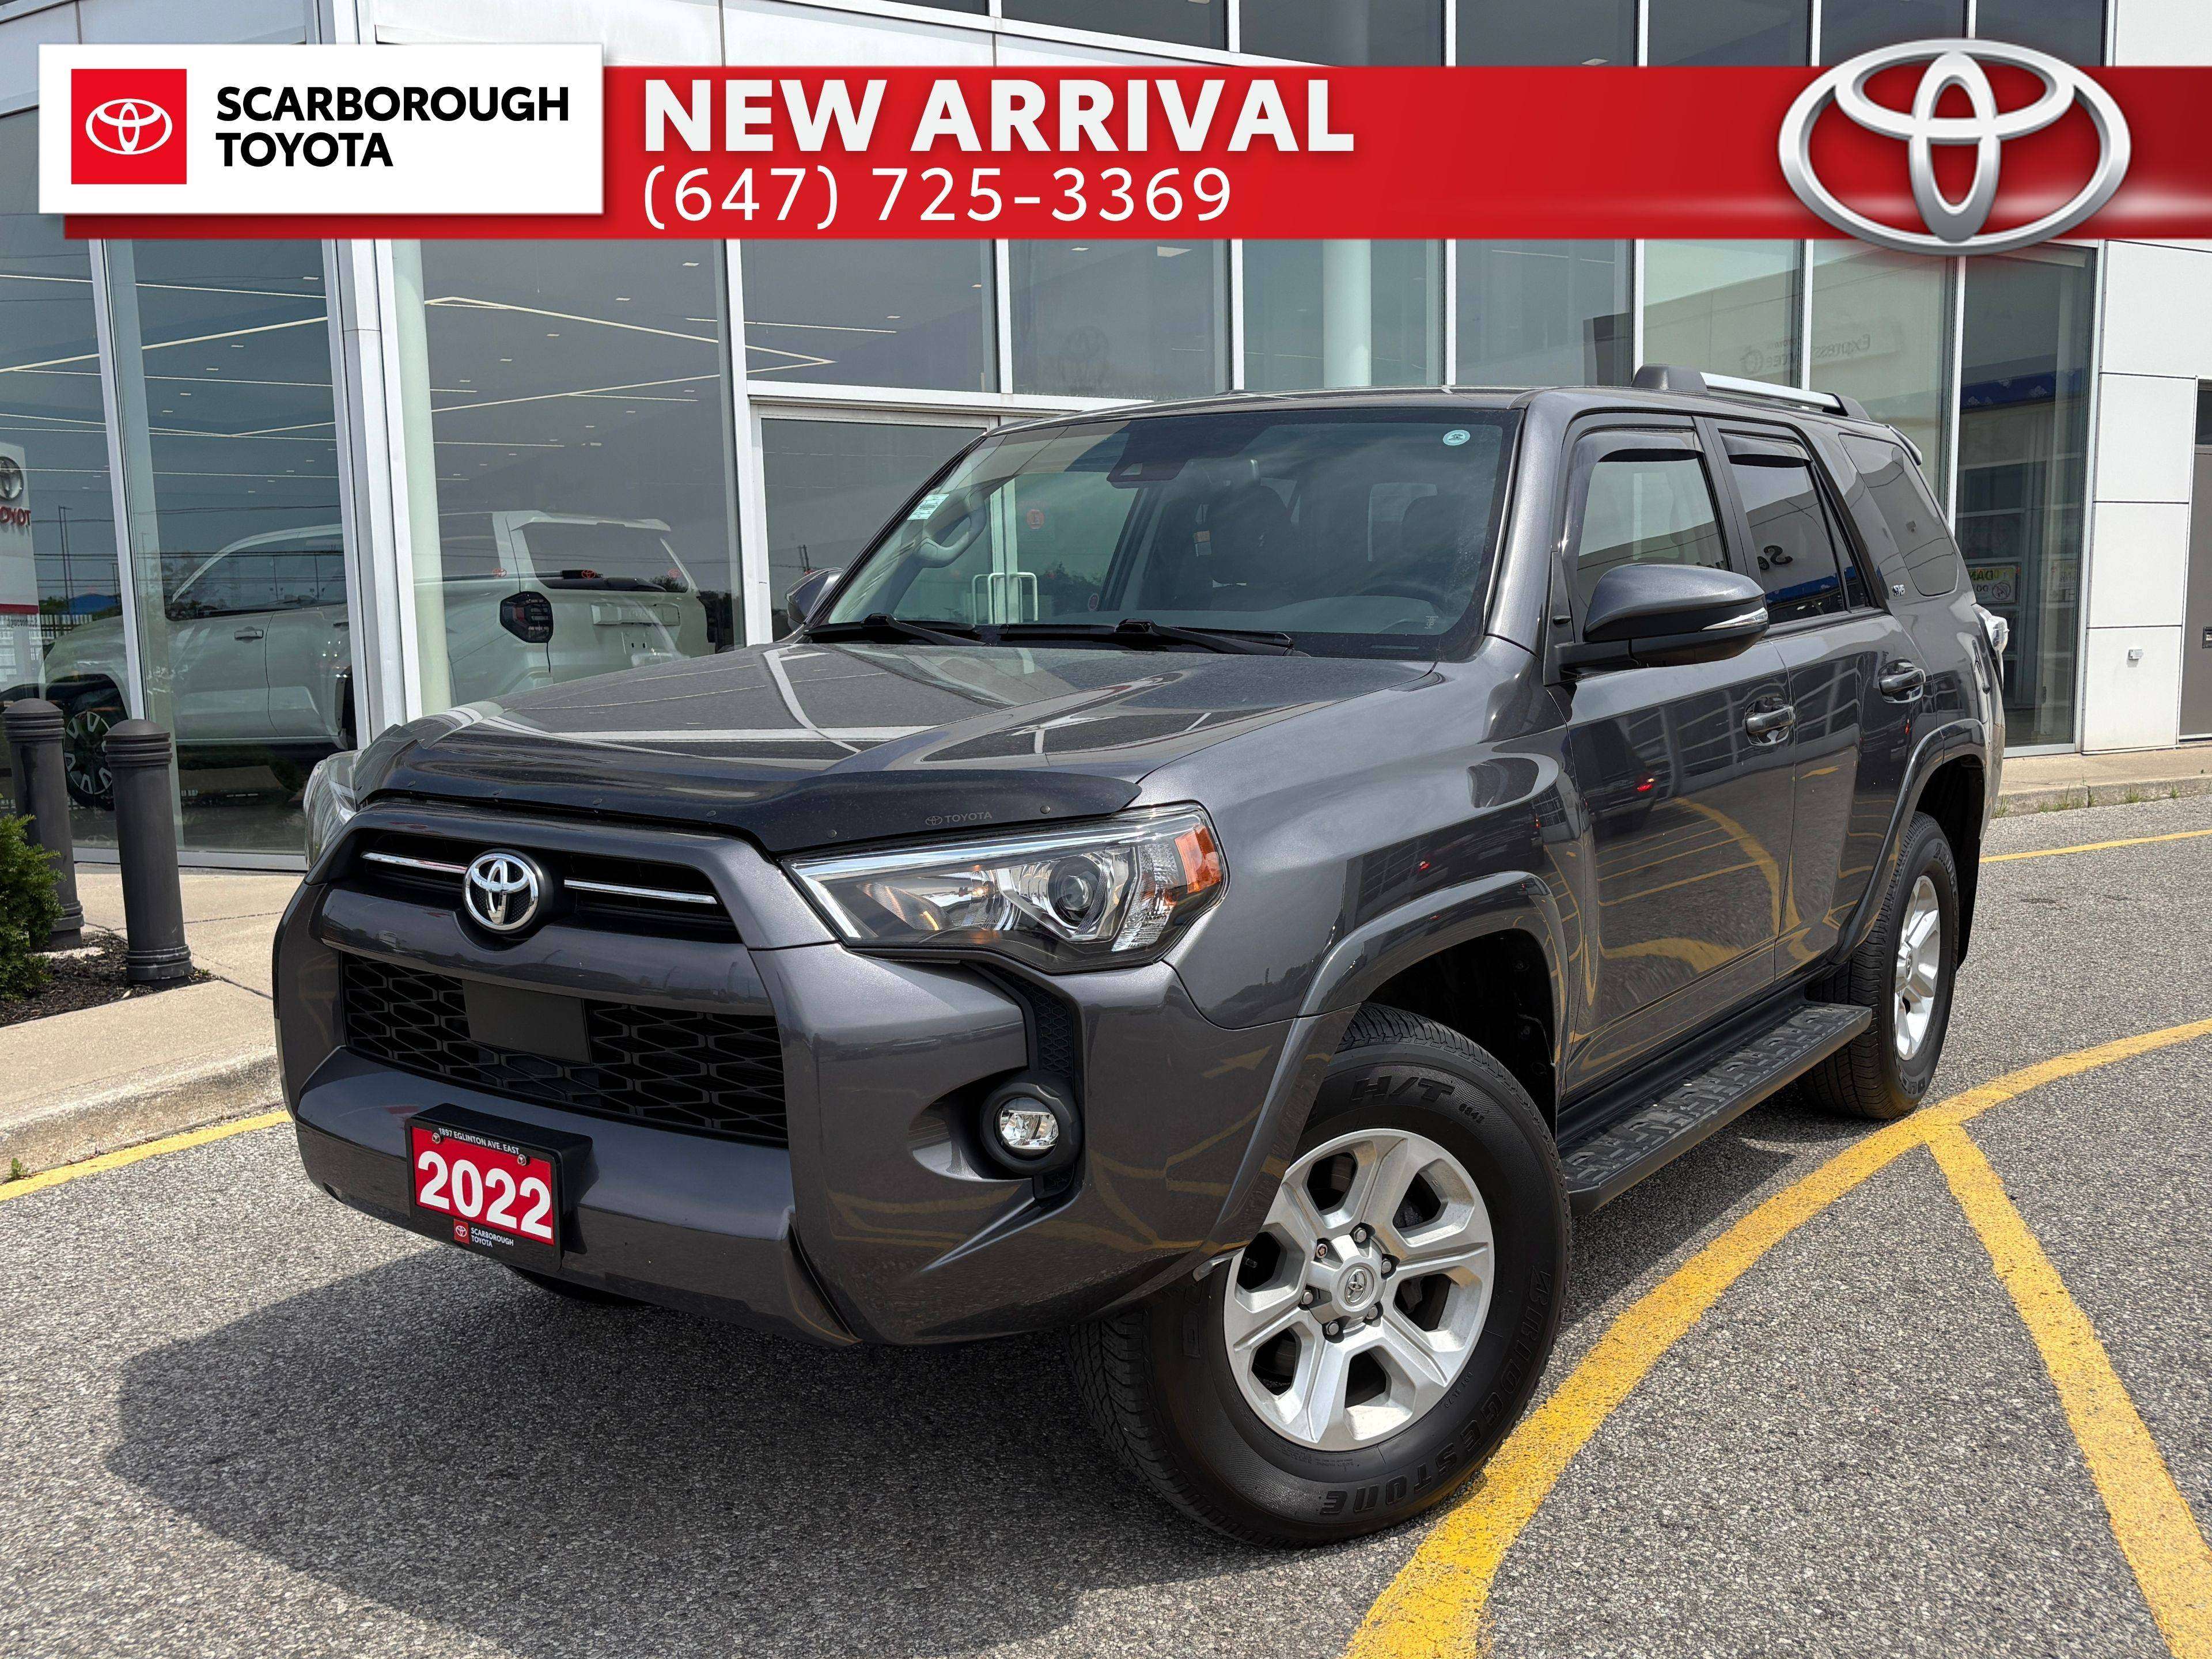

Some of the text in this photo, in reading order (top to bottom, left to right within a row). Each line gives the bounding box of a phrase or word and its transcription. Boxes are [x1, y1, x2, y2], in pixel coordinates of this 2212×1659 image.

[945, 812, 992, 823] TOYOTA
[1350, 1074, 1456, 1103] H/T
[438, 1127, 520, 1156] 1897 EGLINTON AVE. EAST
[418, 1150, 552, 1239] 2022
[471, 1227, 514, 1247] SCARBOROUGH
[471, 1235, 493, 1248] TOYOTA
[1319, 1266, 1552, 1516] BRIDGESTONE
